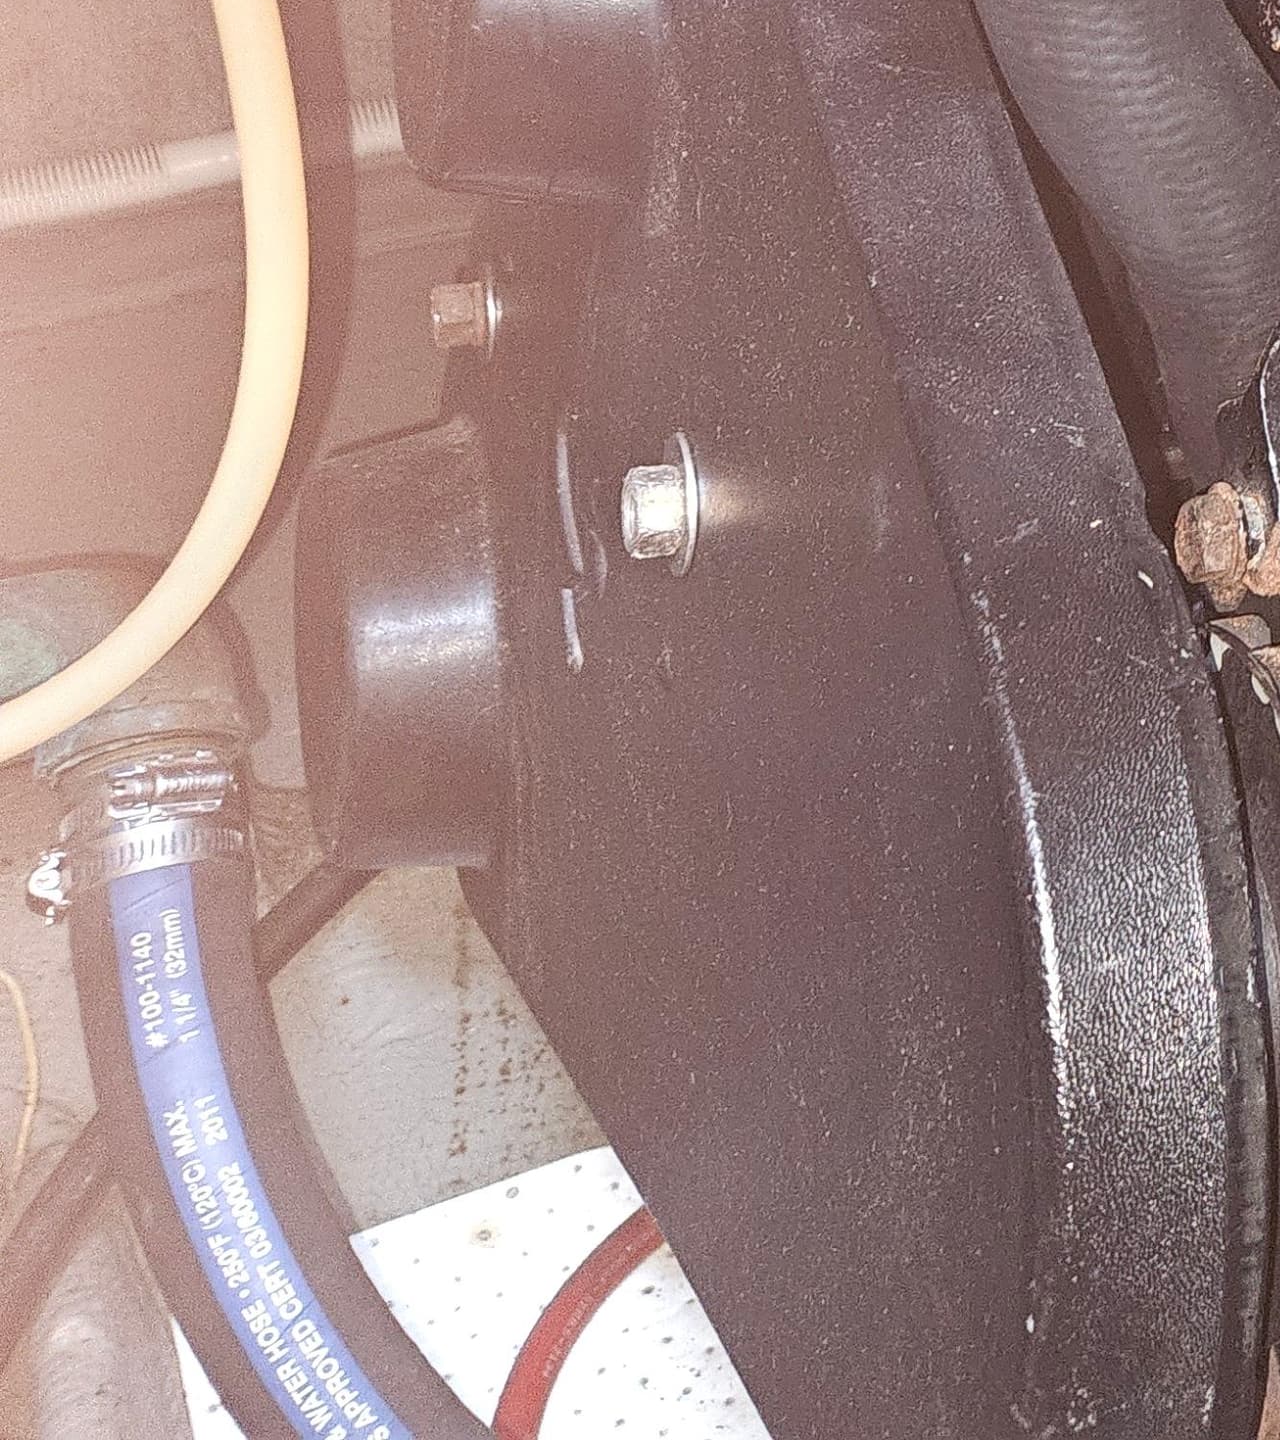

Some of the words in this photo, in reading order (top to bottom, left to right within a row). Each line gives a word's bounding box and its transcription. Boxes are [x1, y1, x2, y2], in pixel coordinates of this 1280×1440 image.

[159, 909, 190, 978] (32mm)
[130, 932, 169, 1049] #100-1140
[163, 1100, 198, 1159] MAX.
[194, 1094, 229, 1146] 2011
[180, 1161, 226, 1231] (120°C)
[256, 1260, 304, 1321] CERT
[240, 1299, 290, 1363] HOSE
[277, 1357, 334, 1432] WATER
[291, 1319, 379, 1428] APPROVED
